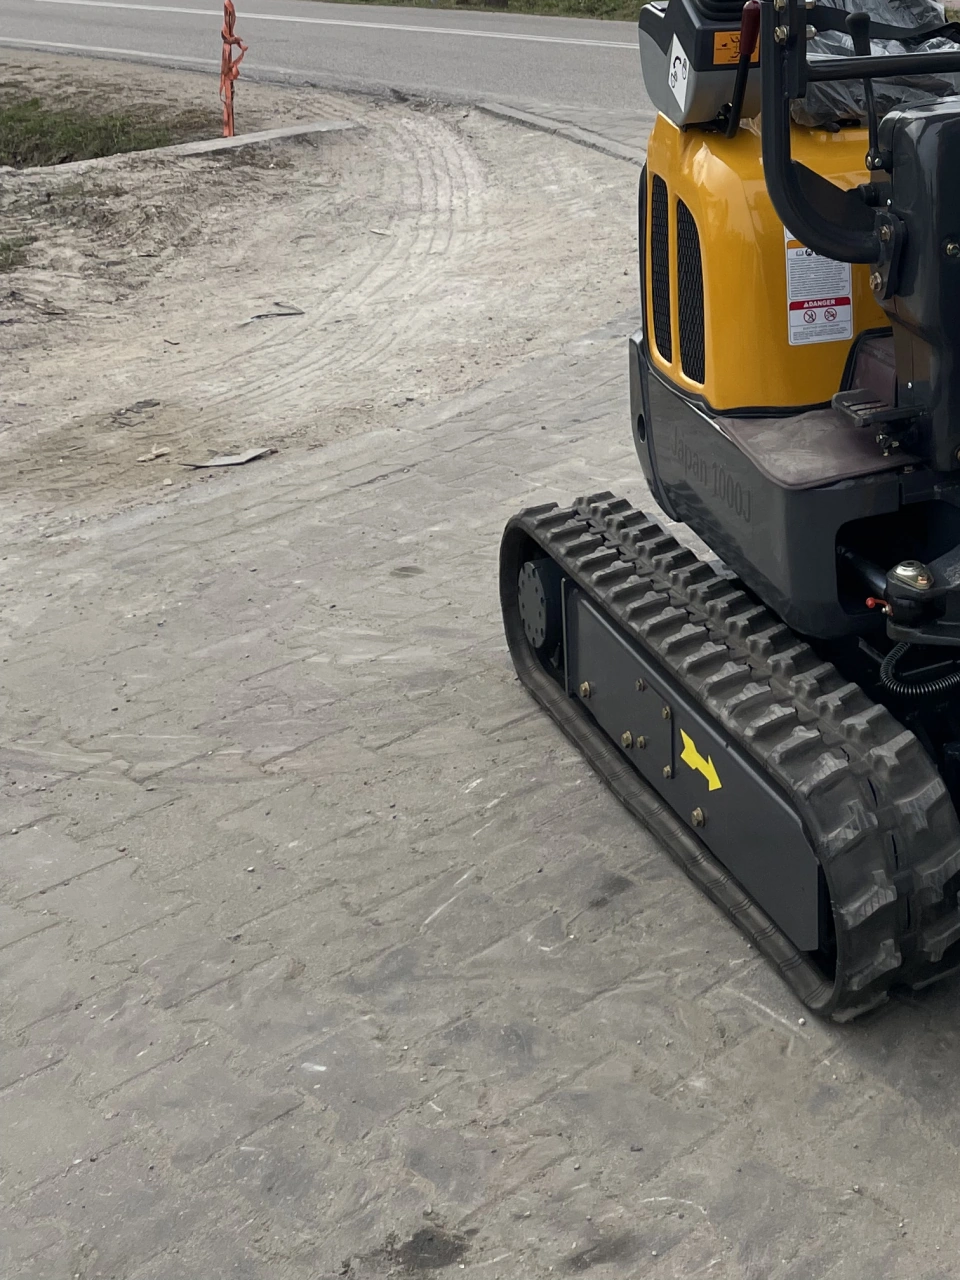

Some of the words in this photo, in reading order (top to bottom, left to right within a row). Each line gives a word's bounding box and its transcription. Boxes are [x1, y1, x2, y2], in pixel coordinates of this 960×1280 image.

[809, 299, 836, 307] DANGER
[671, 425, 707, 487] Japan
[712, 462, 752, 523] 1000J
